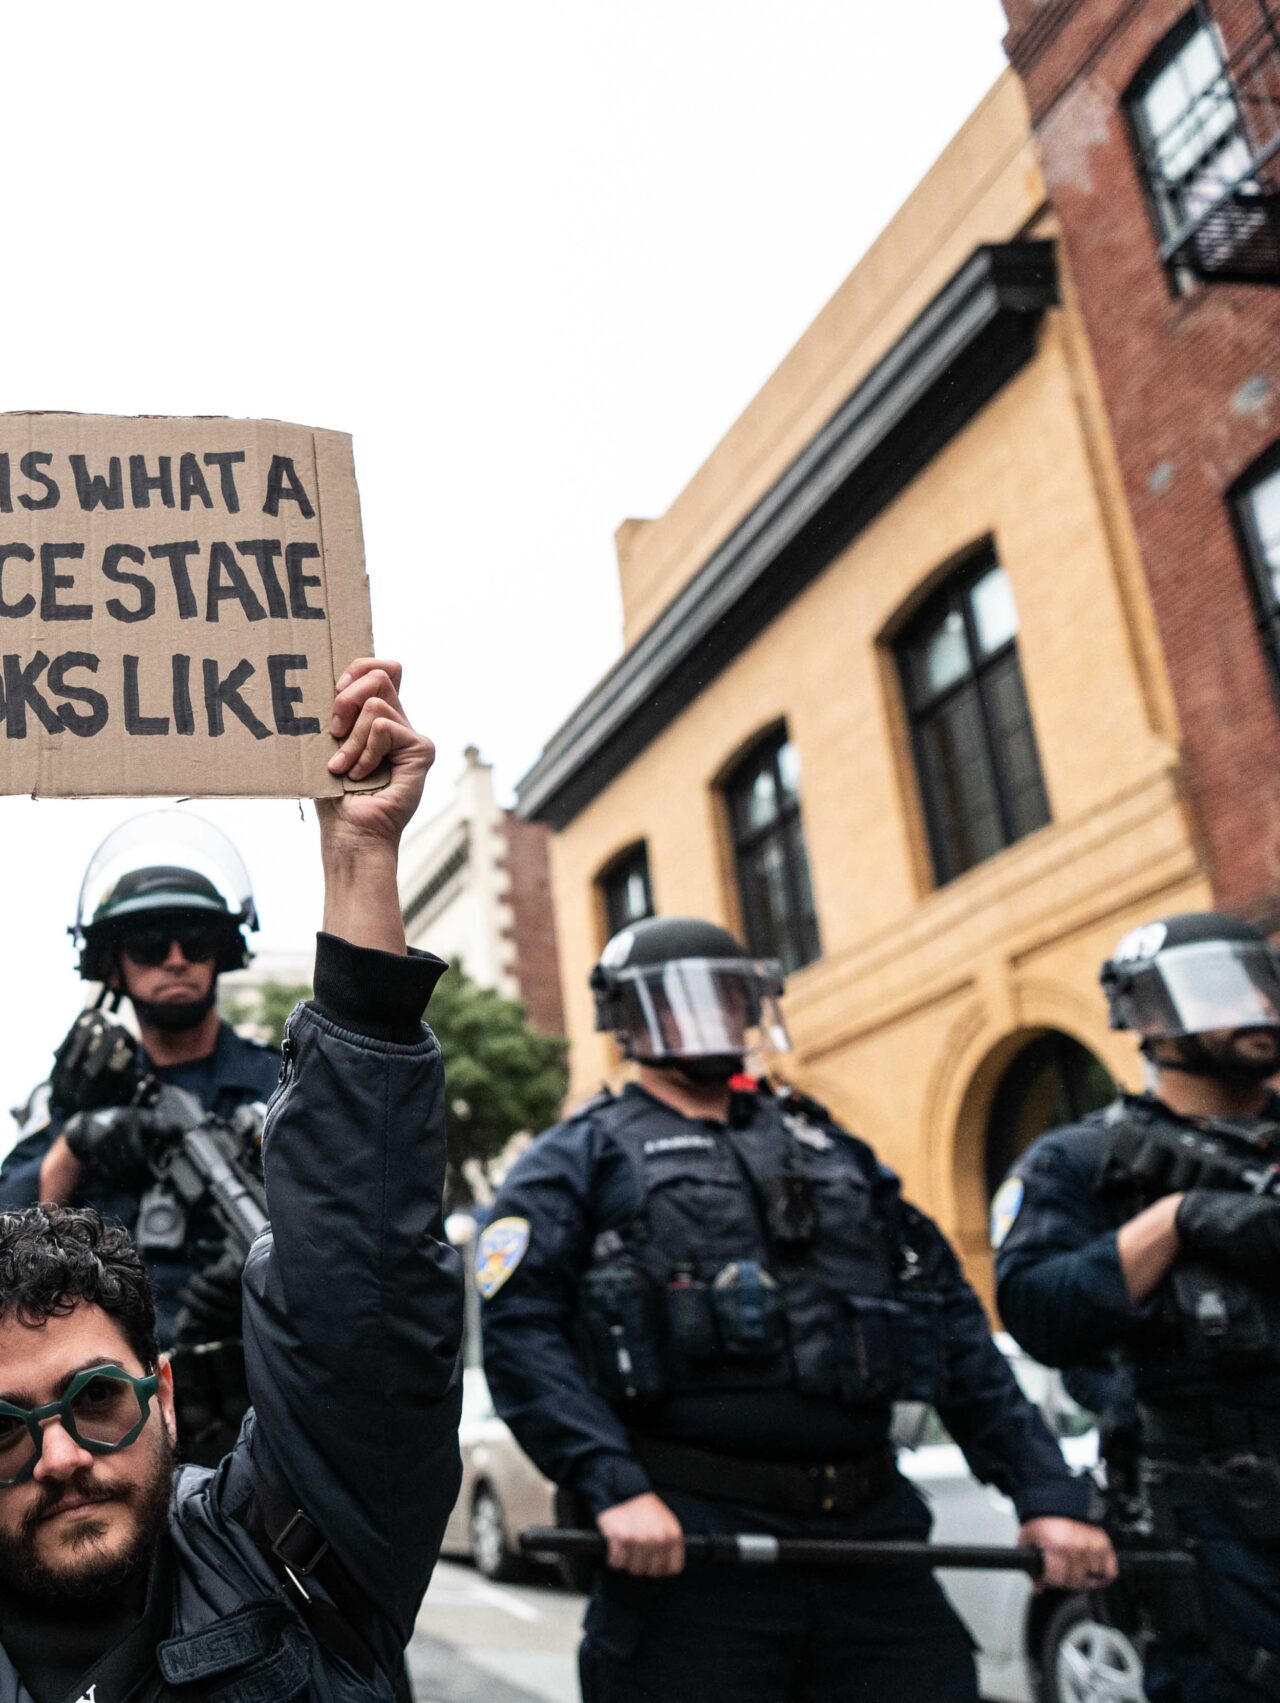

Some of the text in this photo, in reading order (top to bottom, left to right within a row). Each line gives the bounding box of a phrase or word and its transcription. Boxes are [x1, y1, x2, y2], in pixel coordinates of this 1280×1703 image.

[69, 452, 244, 513] WHAT
[263, 455, 315, 518] A
[102, 539, 325, 623] STATE
[123, 654, 321, 739] LIKE
